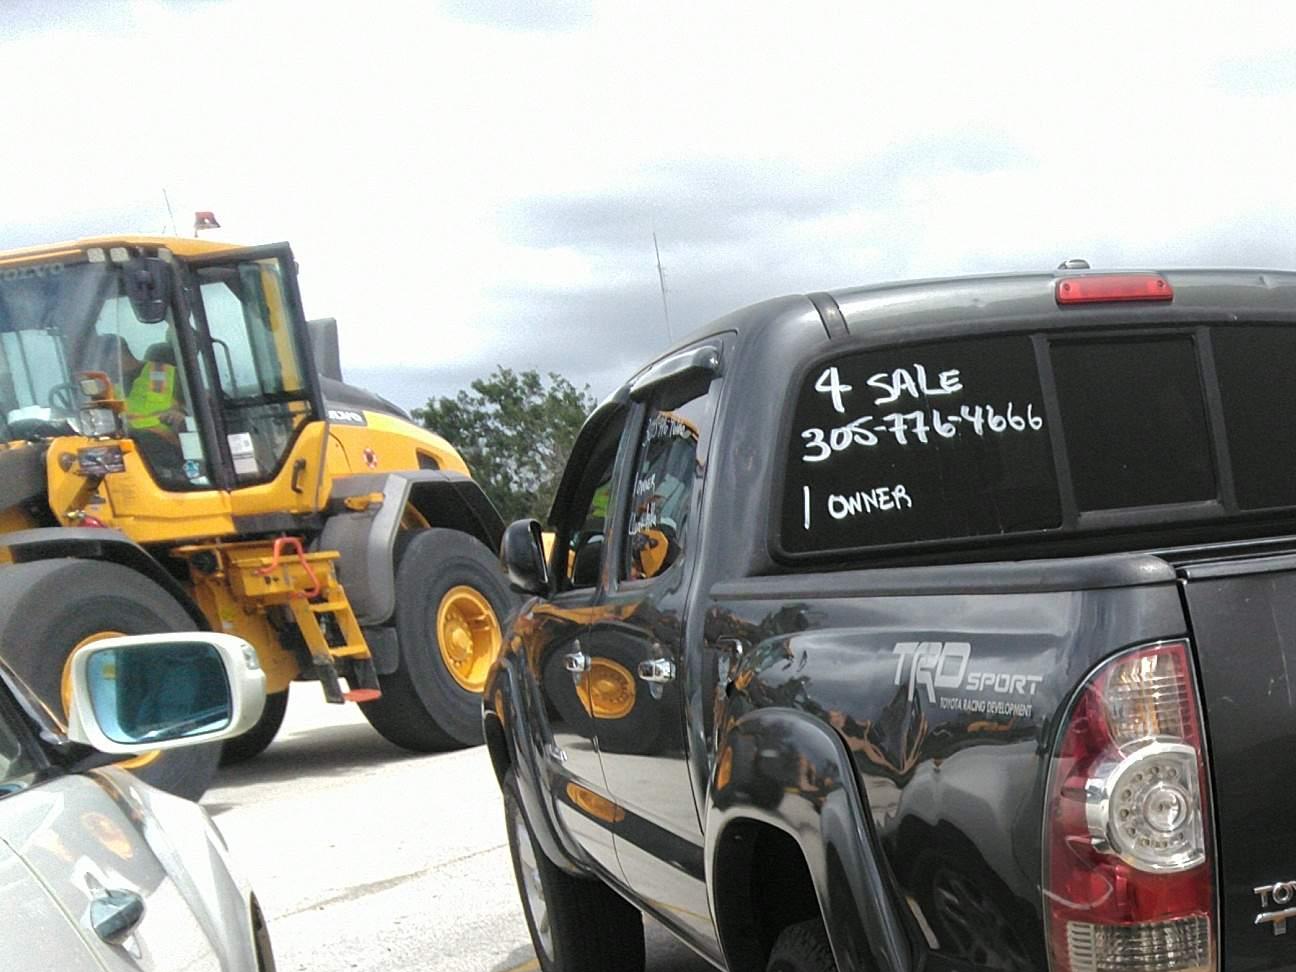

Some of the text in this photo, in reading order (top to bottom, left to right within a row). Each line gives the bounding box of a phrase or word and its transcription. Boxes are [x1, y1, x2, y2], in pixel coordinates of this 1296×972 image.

[0, 262, 64, 282] OLVO
[815, 363, 964, 413] 4 SALE
[801, 401, 1043, 462] 305-776-4666
[803, 484, 913, 529] 1 OWNER
[892, 641, 1043, 703] TRD SPORT
[940, 696, 1033, 717] TOYOTA RACING DEVELOPMENT
